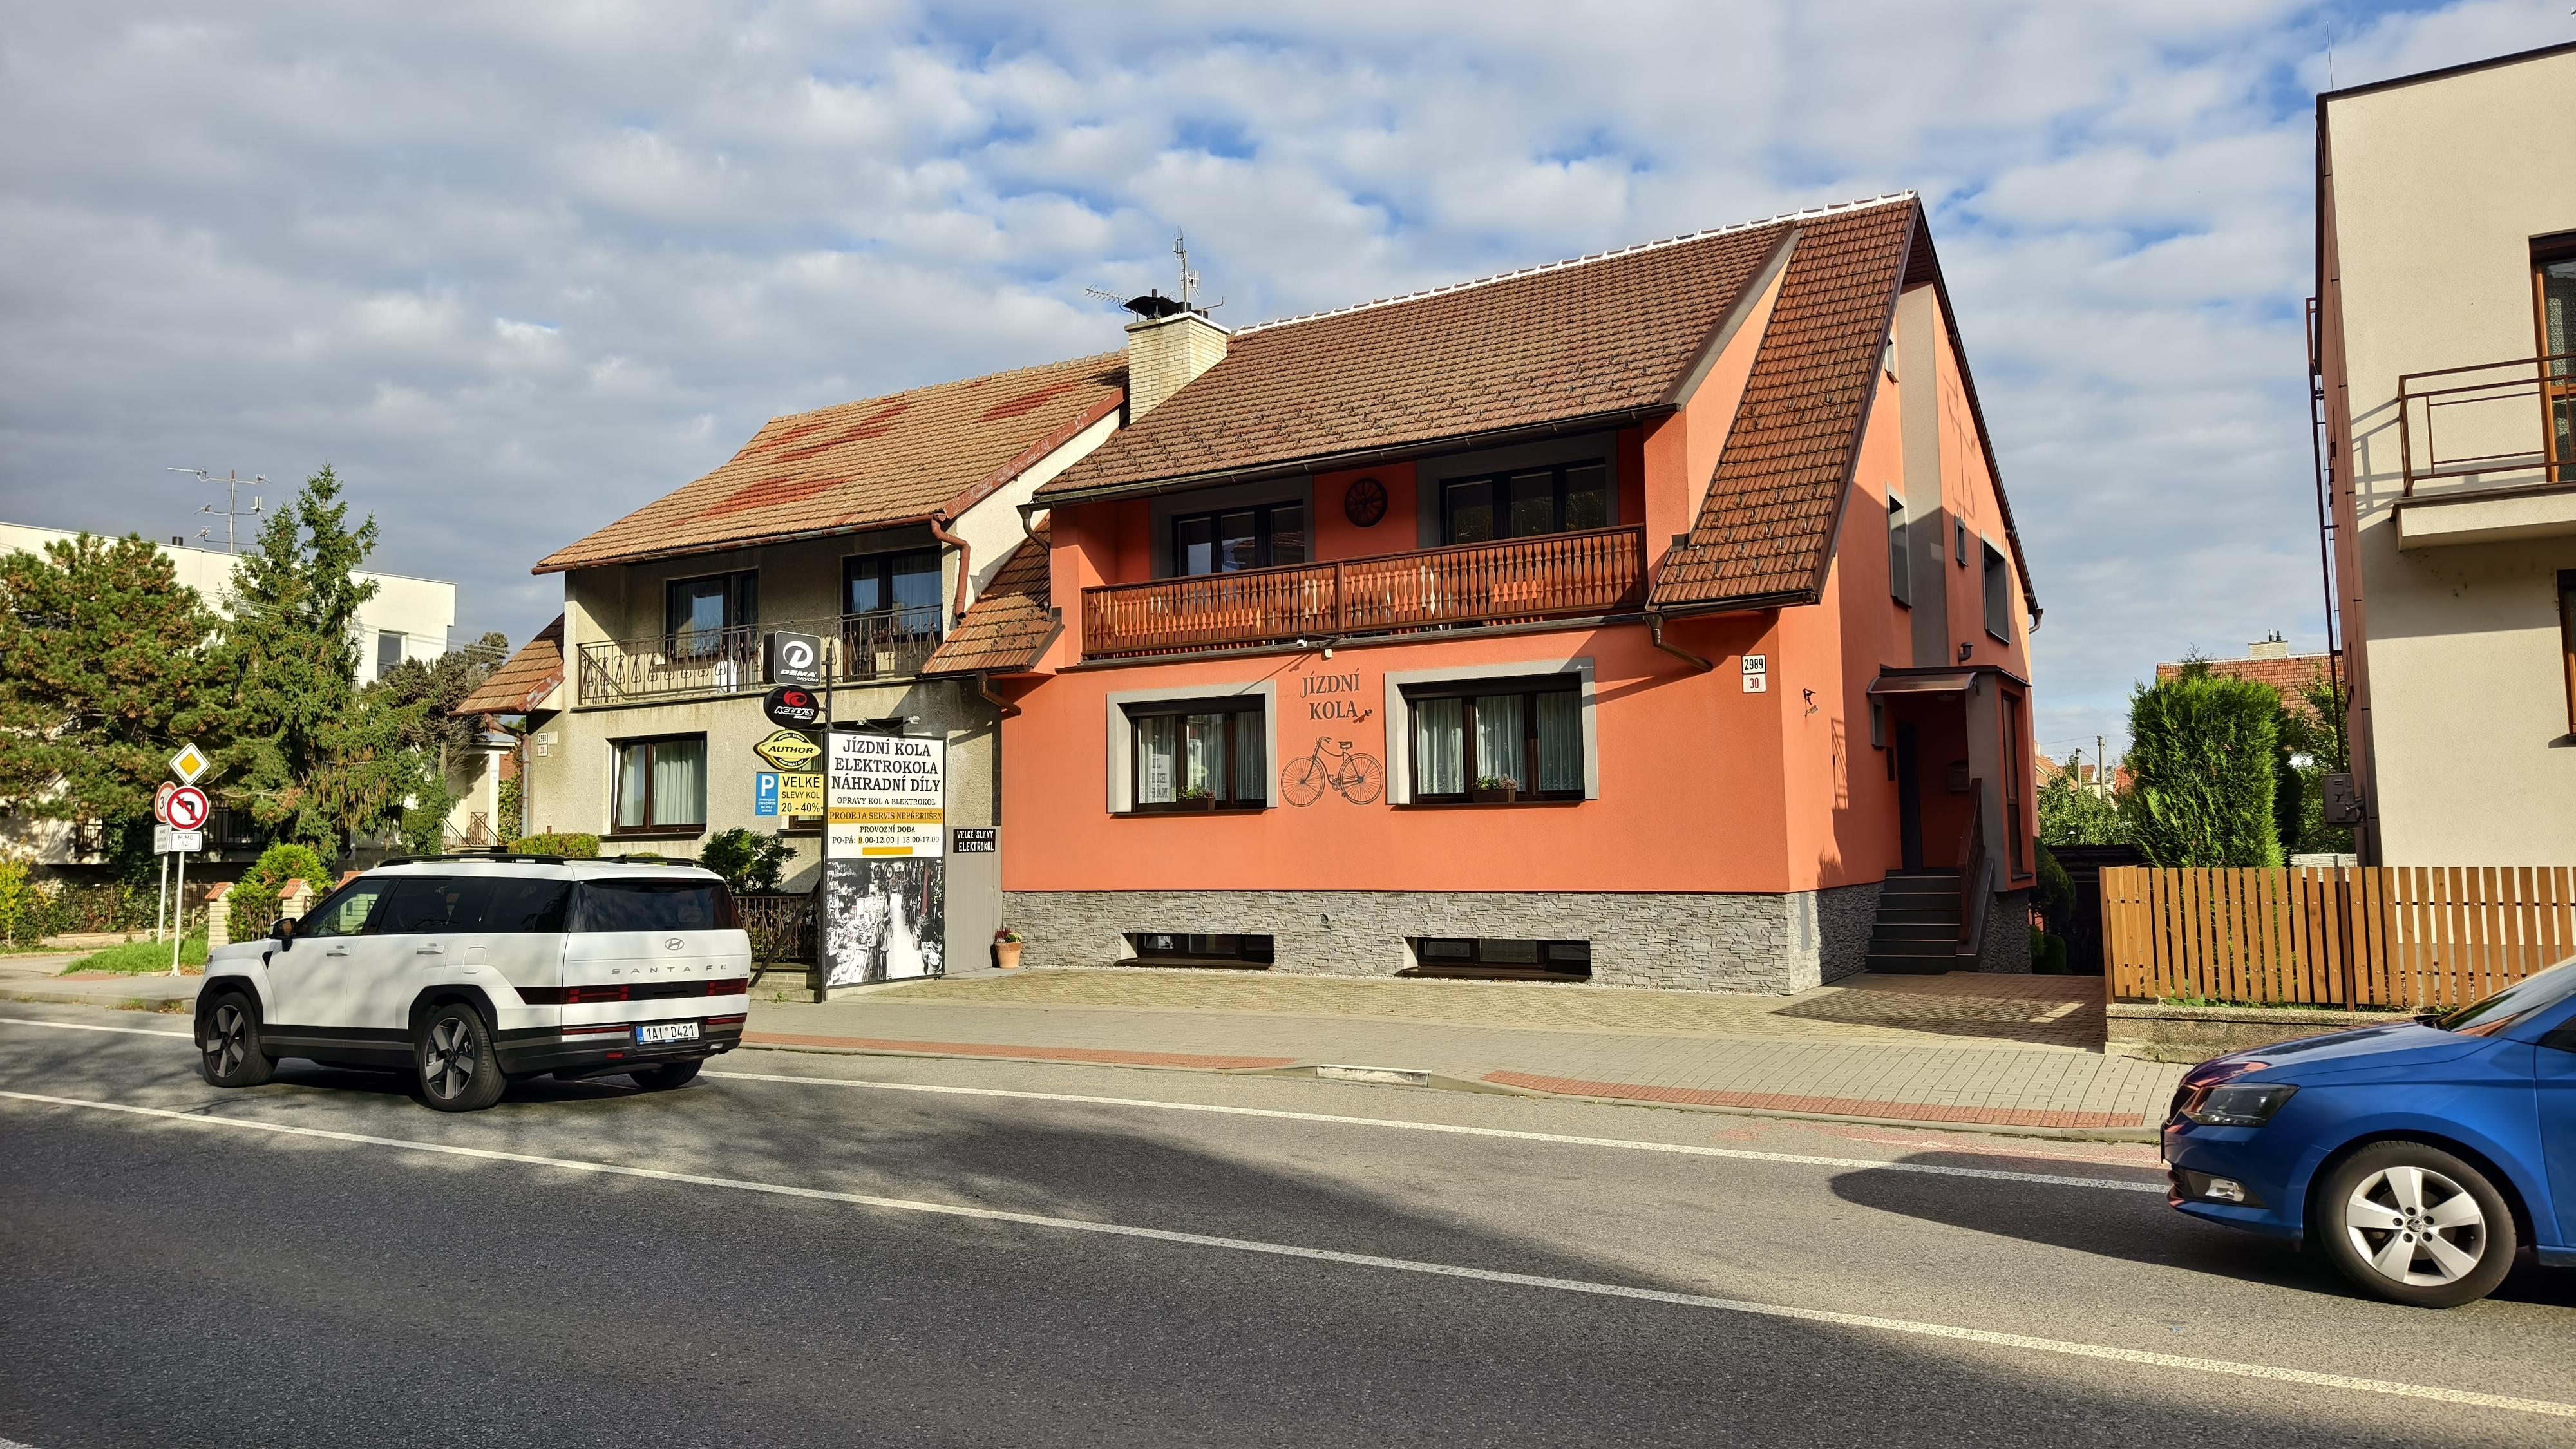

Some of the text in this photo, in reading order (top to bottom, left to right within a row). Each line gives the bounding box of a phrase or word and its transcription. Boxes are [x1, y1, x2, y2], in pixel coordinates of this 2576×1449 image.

[1745, 658, 1763, 670] 2989
[780, 669, 816, 677] DEMA
[1300, 667, 1361, 699] JÍZDNÍ
[1750, 677, 1759, 688] 30
[1309, 700, 1359, 721] KOLA
[843, 736, 931, 757] JÍZDNÍ KOLA
[835, 757, 938, 774] ELEKTROKOLA
[761, 775, 775, 797] P
[782, 774, 820, 788] VELKÉ
[831, 773, 940, 792] NÁHRADNÍ DÍLY
[781, 803, 792, 812] 20
[801, 802, 820, 813] 40%
[829, 811, 860, 820] PRODEJ
[869, 811, 895, 820] SERVIS
[896, 810, 942, 820] NEPŘERUŠEN
[860, 824, 895, 833] PROVOZNÍ
[957, 829, 994, 839] VELKÉ SLEVY
[832, 835, 856, 844] PO-PÁ:
[958, 841, 994, 851] ELEKTROKOL
[611, 966, 691, 974] SANTA
[646, 1025, 694, 1039] 1AI D421
